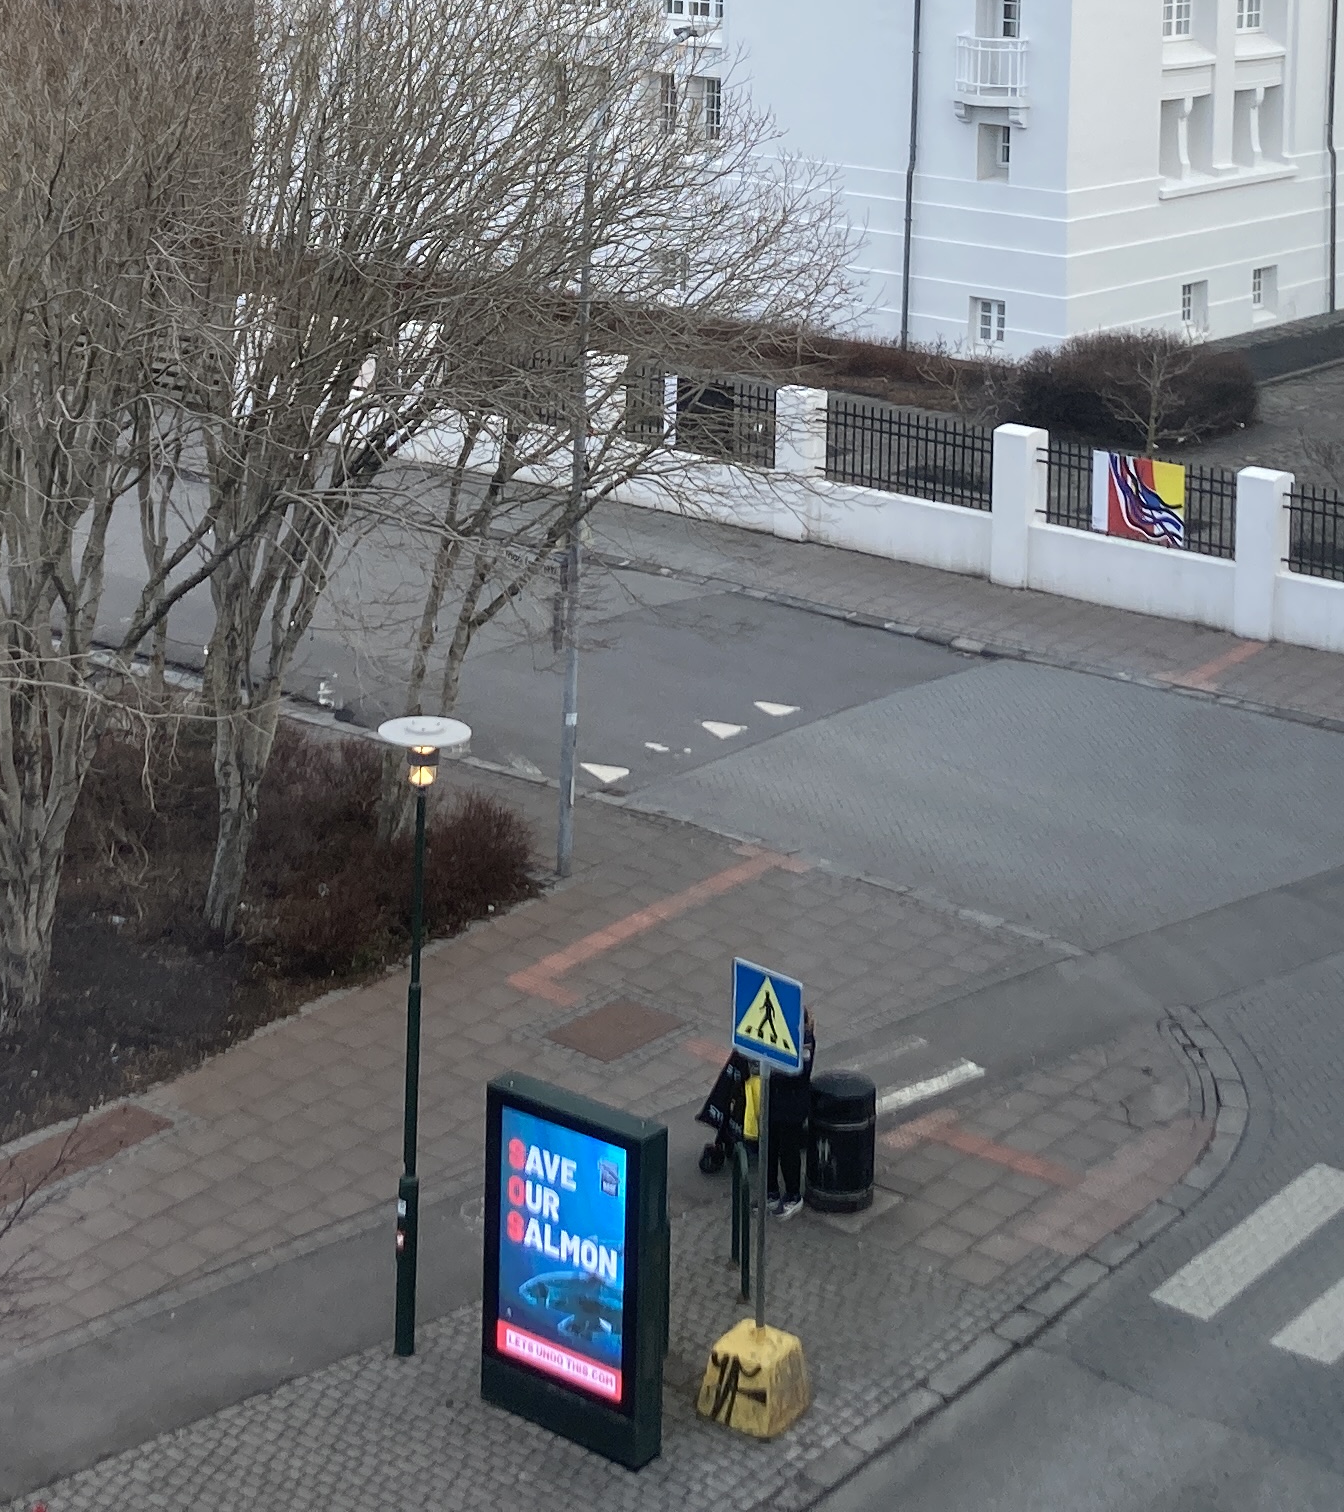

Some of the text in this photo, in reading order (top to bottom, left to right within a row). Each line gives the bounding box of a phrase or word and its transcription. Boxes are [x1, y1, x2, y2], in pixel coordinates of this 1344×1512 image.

[508, 1138, 577, 1192] SAVE
[508, 1174, 560, 1223] OUR
[506, 1210, 618, 1280] SALMON
